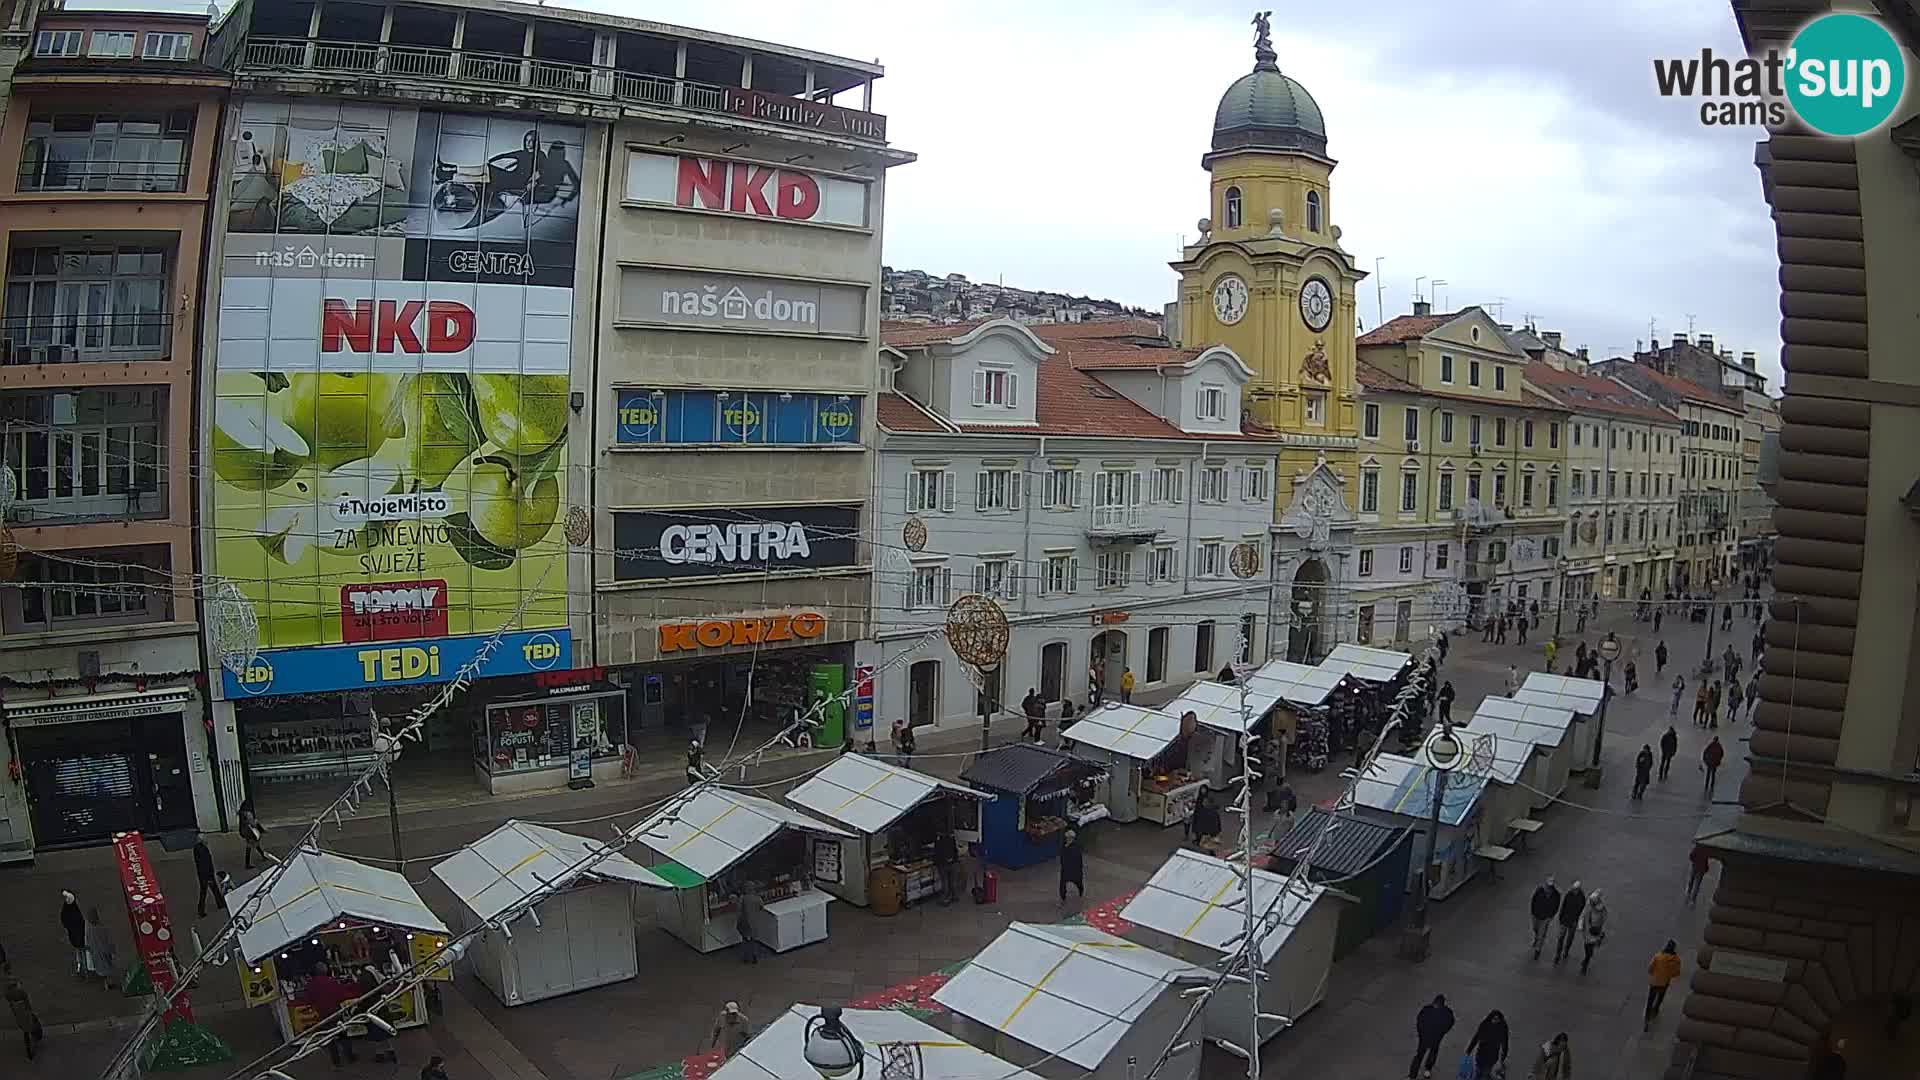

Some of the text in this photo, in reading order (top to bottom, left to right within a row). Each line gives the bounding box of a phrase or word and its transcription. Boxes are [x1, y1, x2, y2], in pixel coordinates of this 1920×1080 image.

[724, 89, 745, 112] Le
[676, 158, 820, 221] NKD
[255, 246, 366, 269] naš dom
[449, 250, 535, 275] CENTRA
[661, 284, 817, 324] naš dom
[322, 298, 477, 354] NKD
[619, 408, 658, 426] TEDi
[723, 409, 760, 427] TEDi
[819, 410, 853, 427] TEDi
[339, 498, 446, 516] #TvojeMisto
[334, 523, 451, 549] ZA DNEVNO
[660, 521, 811, 564] CENTRA
[360, 547, 427, 575] SVJEŽE
[349, 587, 439, 614] TOMMY
[660, 613, 826, 652] KORZO
[358, 645, 440, 682] TEDi
[522, 642, 560, 661] TEDi
